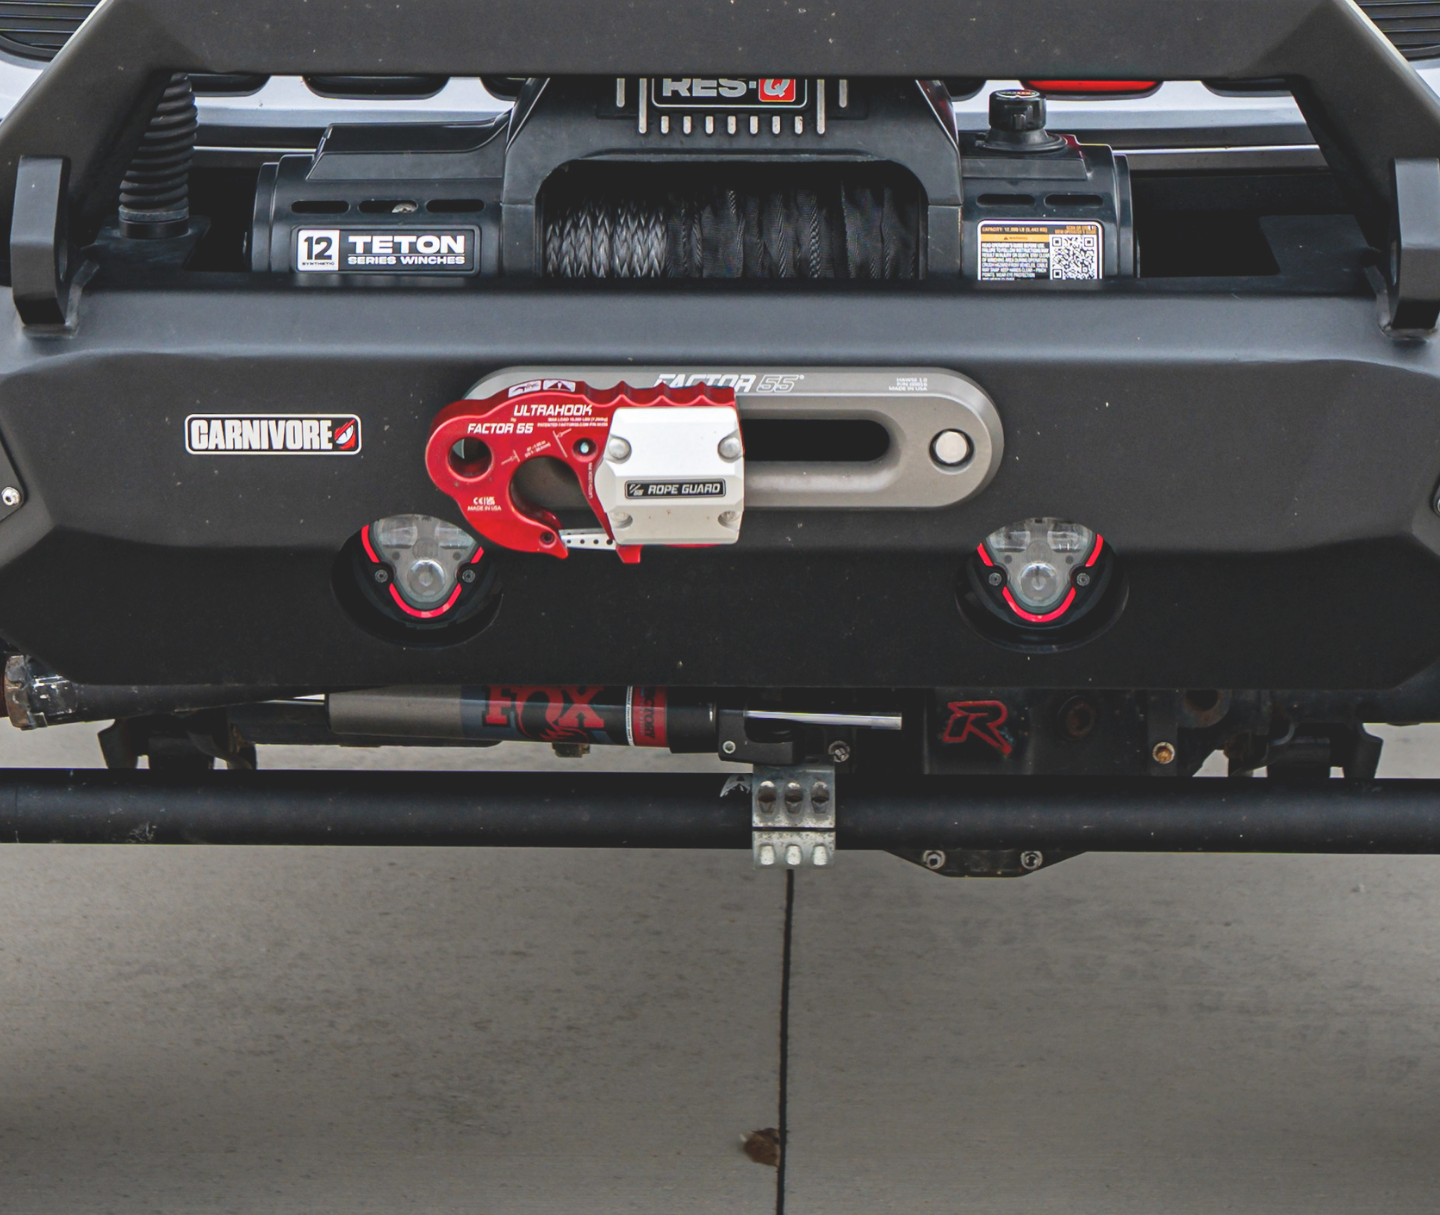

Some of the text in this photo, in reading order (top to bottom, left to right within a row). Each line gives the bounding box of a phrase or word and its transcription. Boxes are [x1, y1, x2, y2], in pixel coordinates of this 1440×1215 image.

[304, 235, 465, 261] 12 TETON
[348, 256, 397, 265] SERIES
[400, 256, 465, 265] WINCHES
[513, 404, 592, 416] ULTRAHOOK
[467, 423, 534, 434] FACTOR 55
[190, 420, 333, 450] CARNIVORE
[648, 484, 679, 495] ROPE
[681, 483, 720, 494] GUARD
[485, 685, 605, 742] FOX
